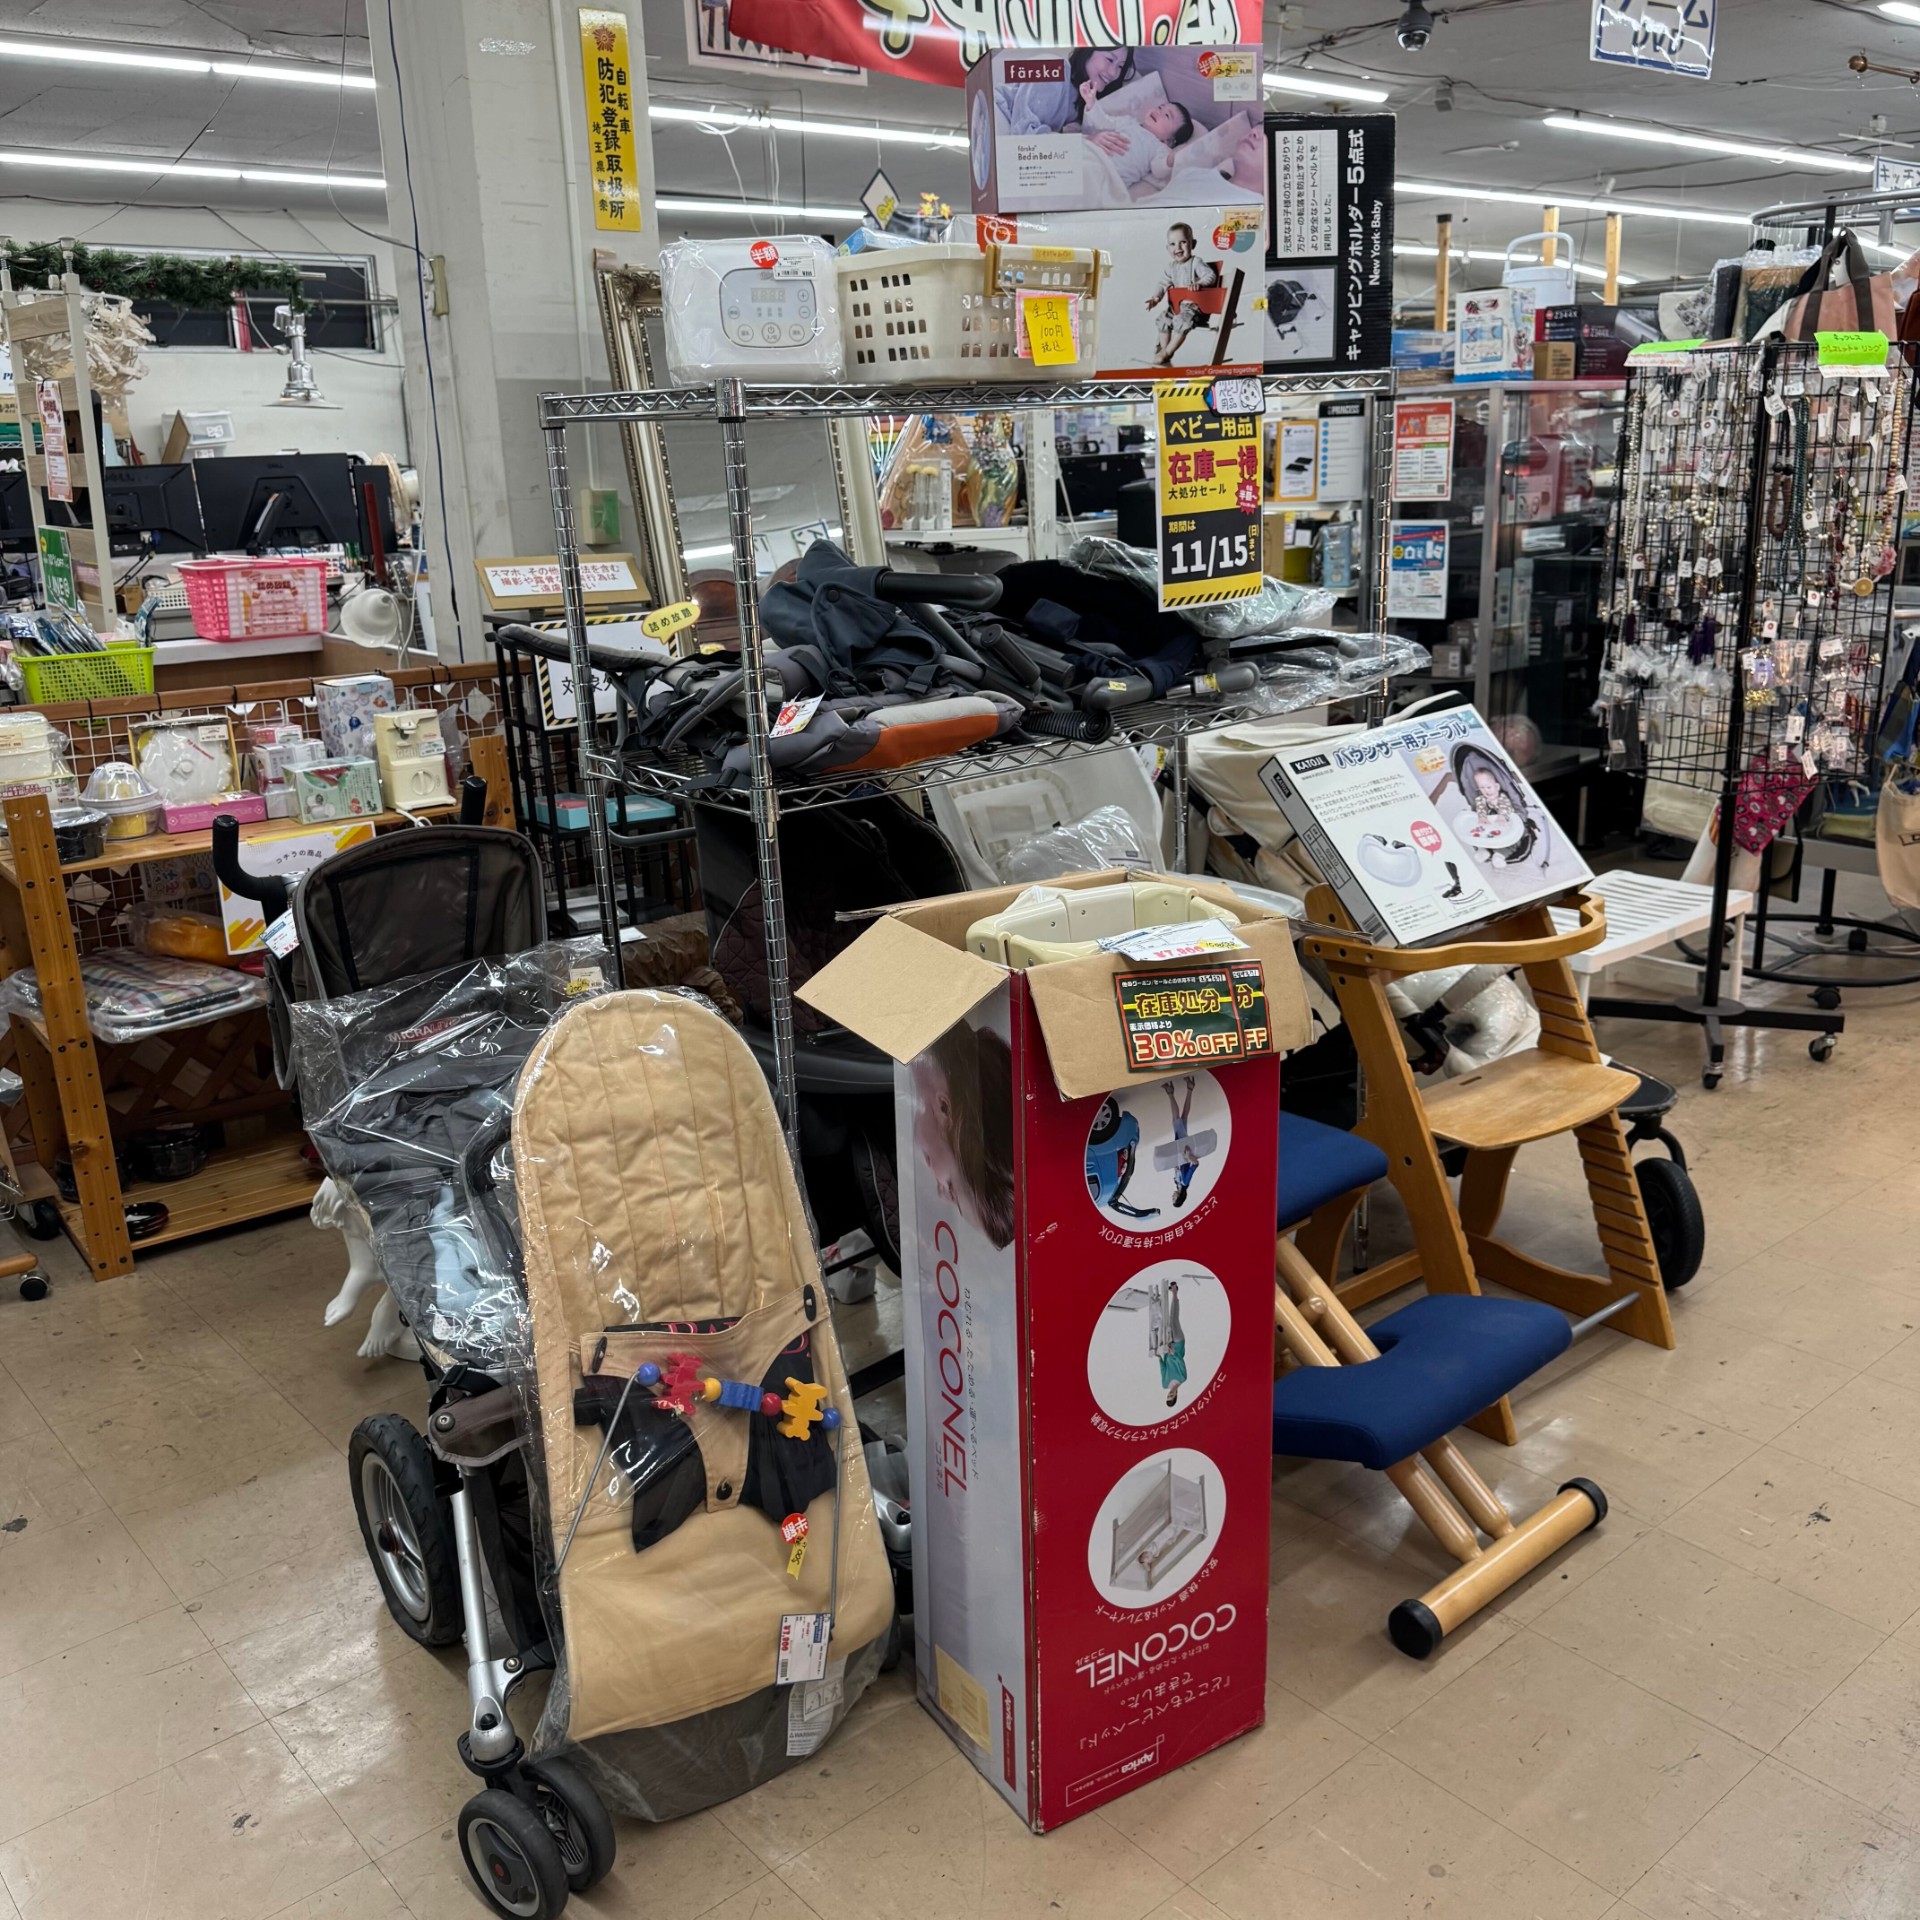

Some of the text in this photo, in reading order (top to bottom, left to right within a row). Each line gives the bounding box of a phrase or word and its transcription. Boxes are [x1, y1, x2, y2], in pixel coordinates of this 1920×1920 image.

[1010, 64, 1061, 78] färska
[614, 68, 631, 134] 自転車
[597, 57, 625, 219] 防犯登録取扱所
[1283, 136, 1291, 252] 元気なお子様の立ちあがりや
[1296, 136, 1304, 252] 万が一の転落を防止するため
[1310, 145, 1318, 251] より安全なシートベルトを
[1324, 193, 1332, 251] 採用しました。
[752, 246, 778, 263] 半額
[1369, 267, 1380, 285] New
[1033, 302, 1059, 320] 全品
[1041, 324, 1064, 338] 100円
[1169, 416, 1254, 440] ベビー用品
[1168, 445, 1258, 485] 在庫一掃
[1168, 486, 1226, 500] 大処分セール
[1168, 520, 1196, 533] 期間は
[1172, 535, 1248, 577] 11/15
[648, 607, 693, 634] 詰め放題
[276, 849, 322, 863] コチラの商品
[1134, 987, 1221, 1019] 在庫処分
[1129, 1021, 1173, 1031] 表示価格より
[1132, 1029, 1238, 1061] 30%OFF
[1098, 1196, 1218, 1249] どこでも自由に持ち運びOK
[934, 1220, 967, 1498] COCONEL
[1091, 1372, 1227, 1441] コンパクトにたたんでラクラク収納
[782, 1517, 808, 1542] 半額
[1075, 1603, 1237, 1689] COCONEL
[1075, 1647, 1106, 1667] ココネル
[1119, 1671, 1193, 1709] できました。
[1121, 1751, 1155, 1775] Aprica
